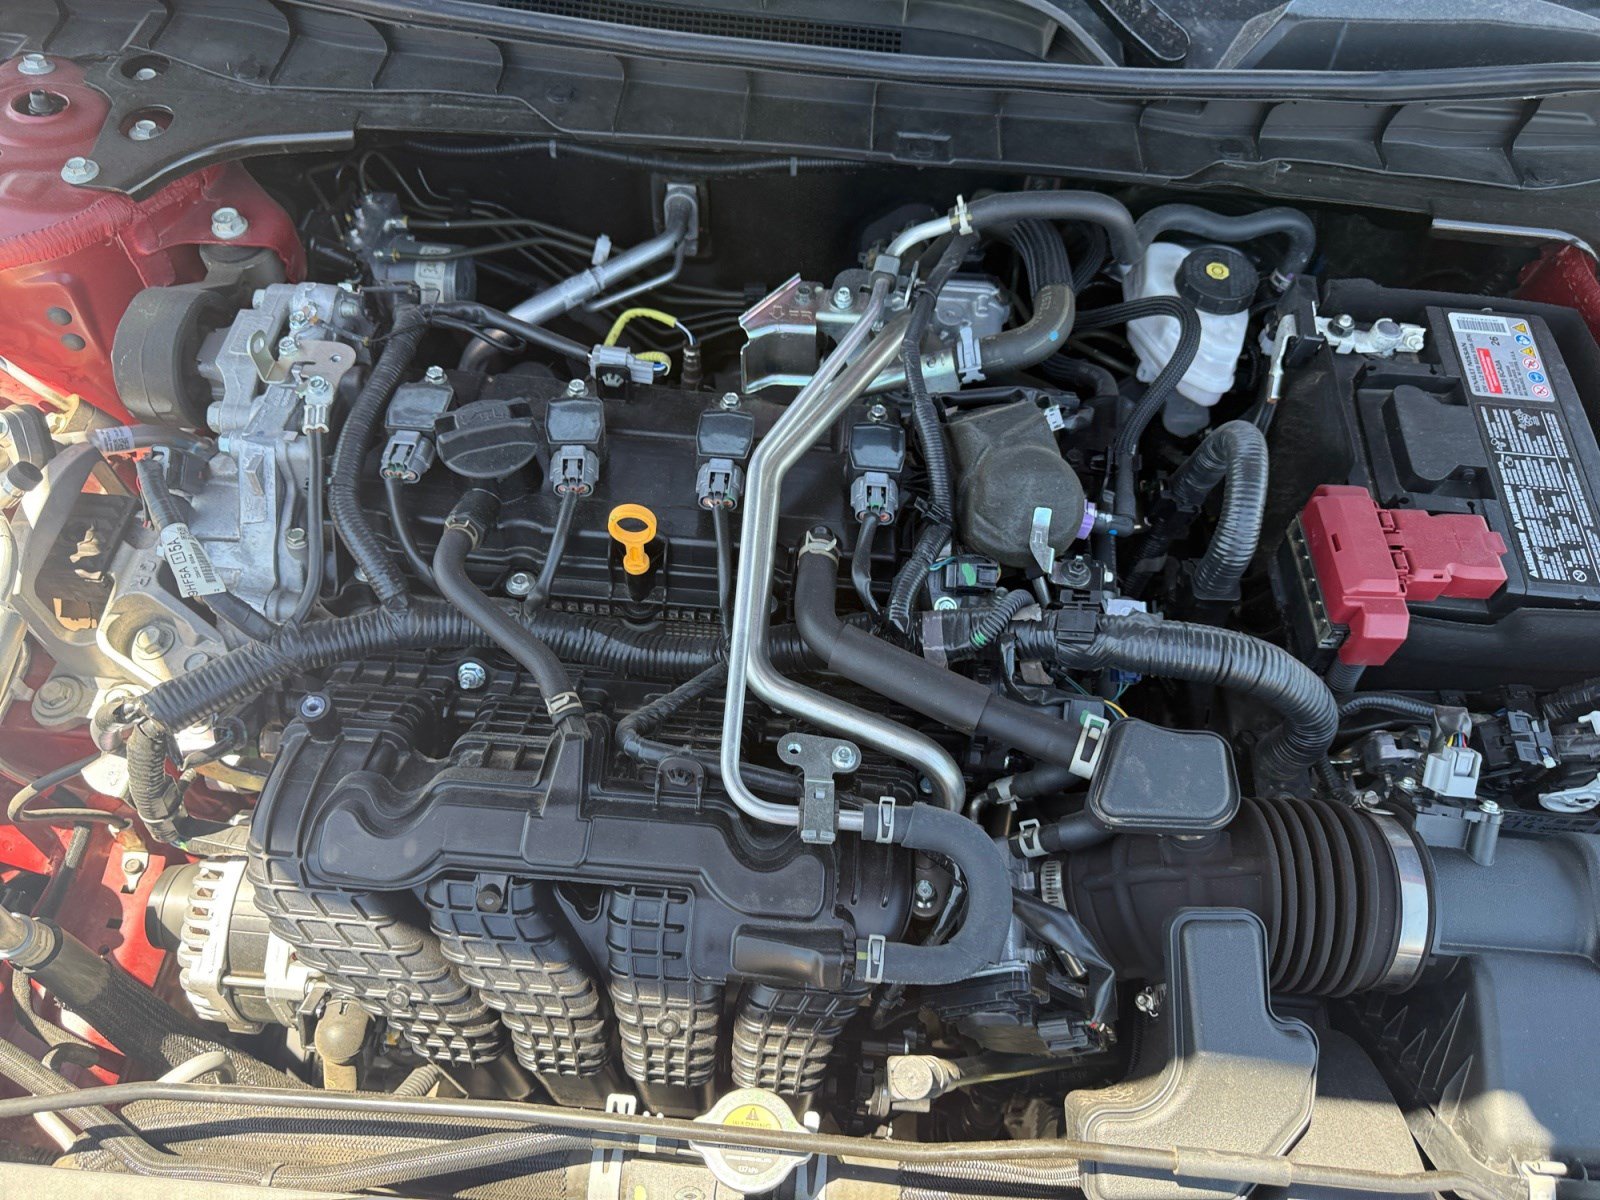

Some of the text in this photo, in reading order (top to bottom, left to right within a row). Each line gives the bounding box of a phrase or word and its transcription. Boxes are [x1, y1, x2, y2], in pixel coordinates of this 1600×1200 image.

[1489, 336, 1500, 346] 26
[1461, 342, 1473, 367] NISSAN
[1469, 368, 1482, 393] RENAULT
[167, 537, 183, 552] 5A
